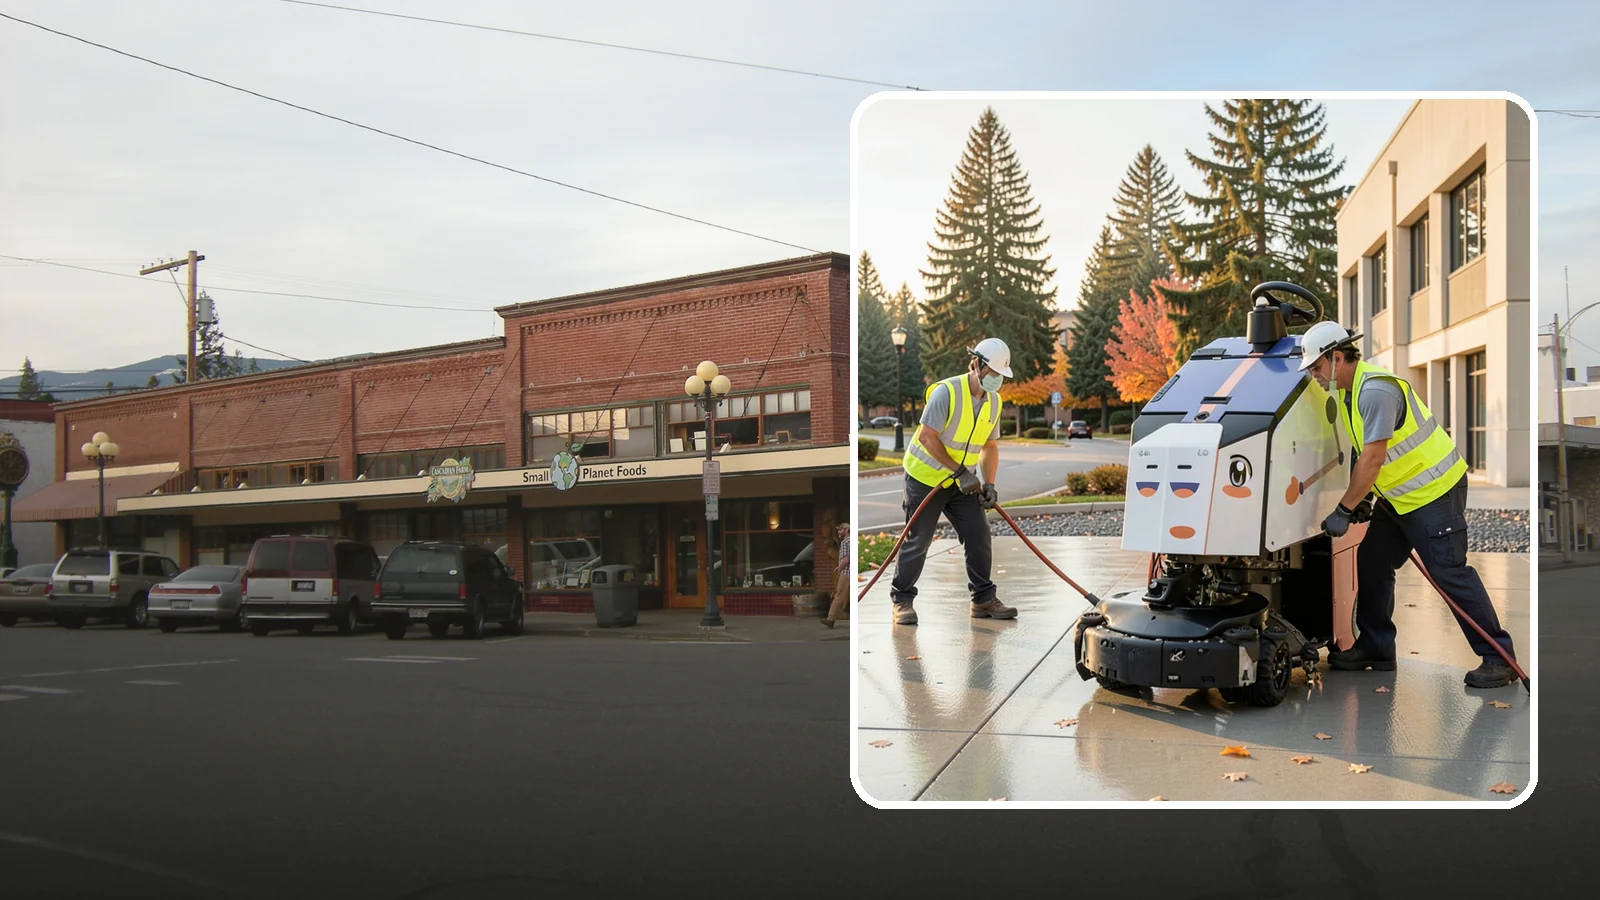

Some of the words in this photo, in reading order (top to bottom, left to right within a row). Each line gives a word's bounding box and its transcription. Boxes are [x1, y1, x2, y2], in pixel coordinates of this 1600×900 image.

[523, 471, 549, 483] Small
[582, 467, 614, 479] Planet
[617, 464, 647, 477] Foods
